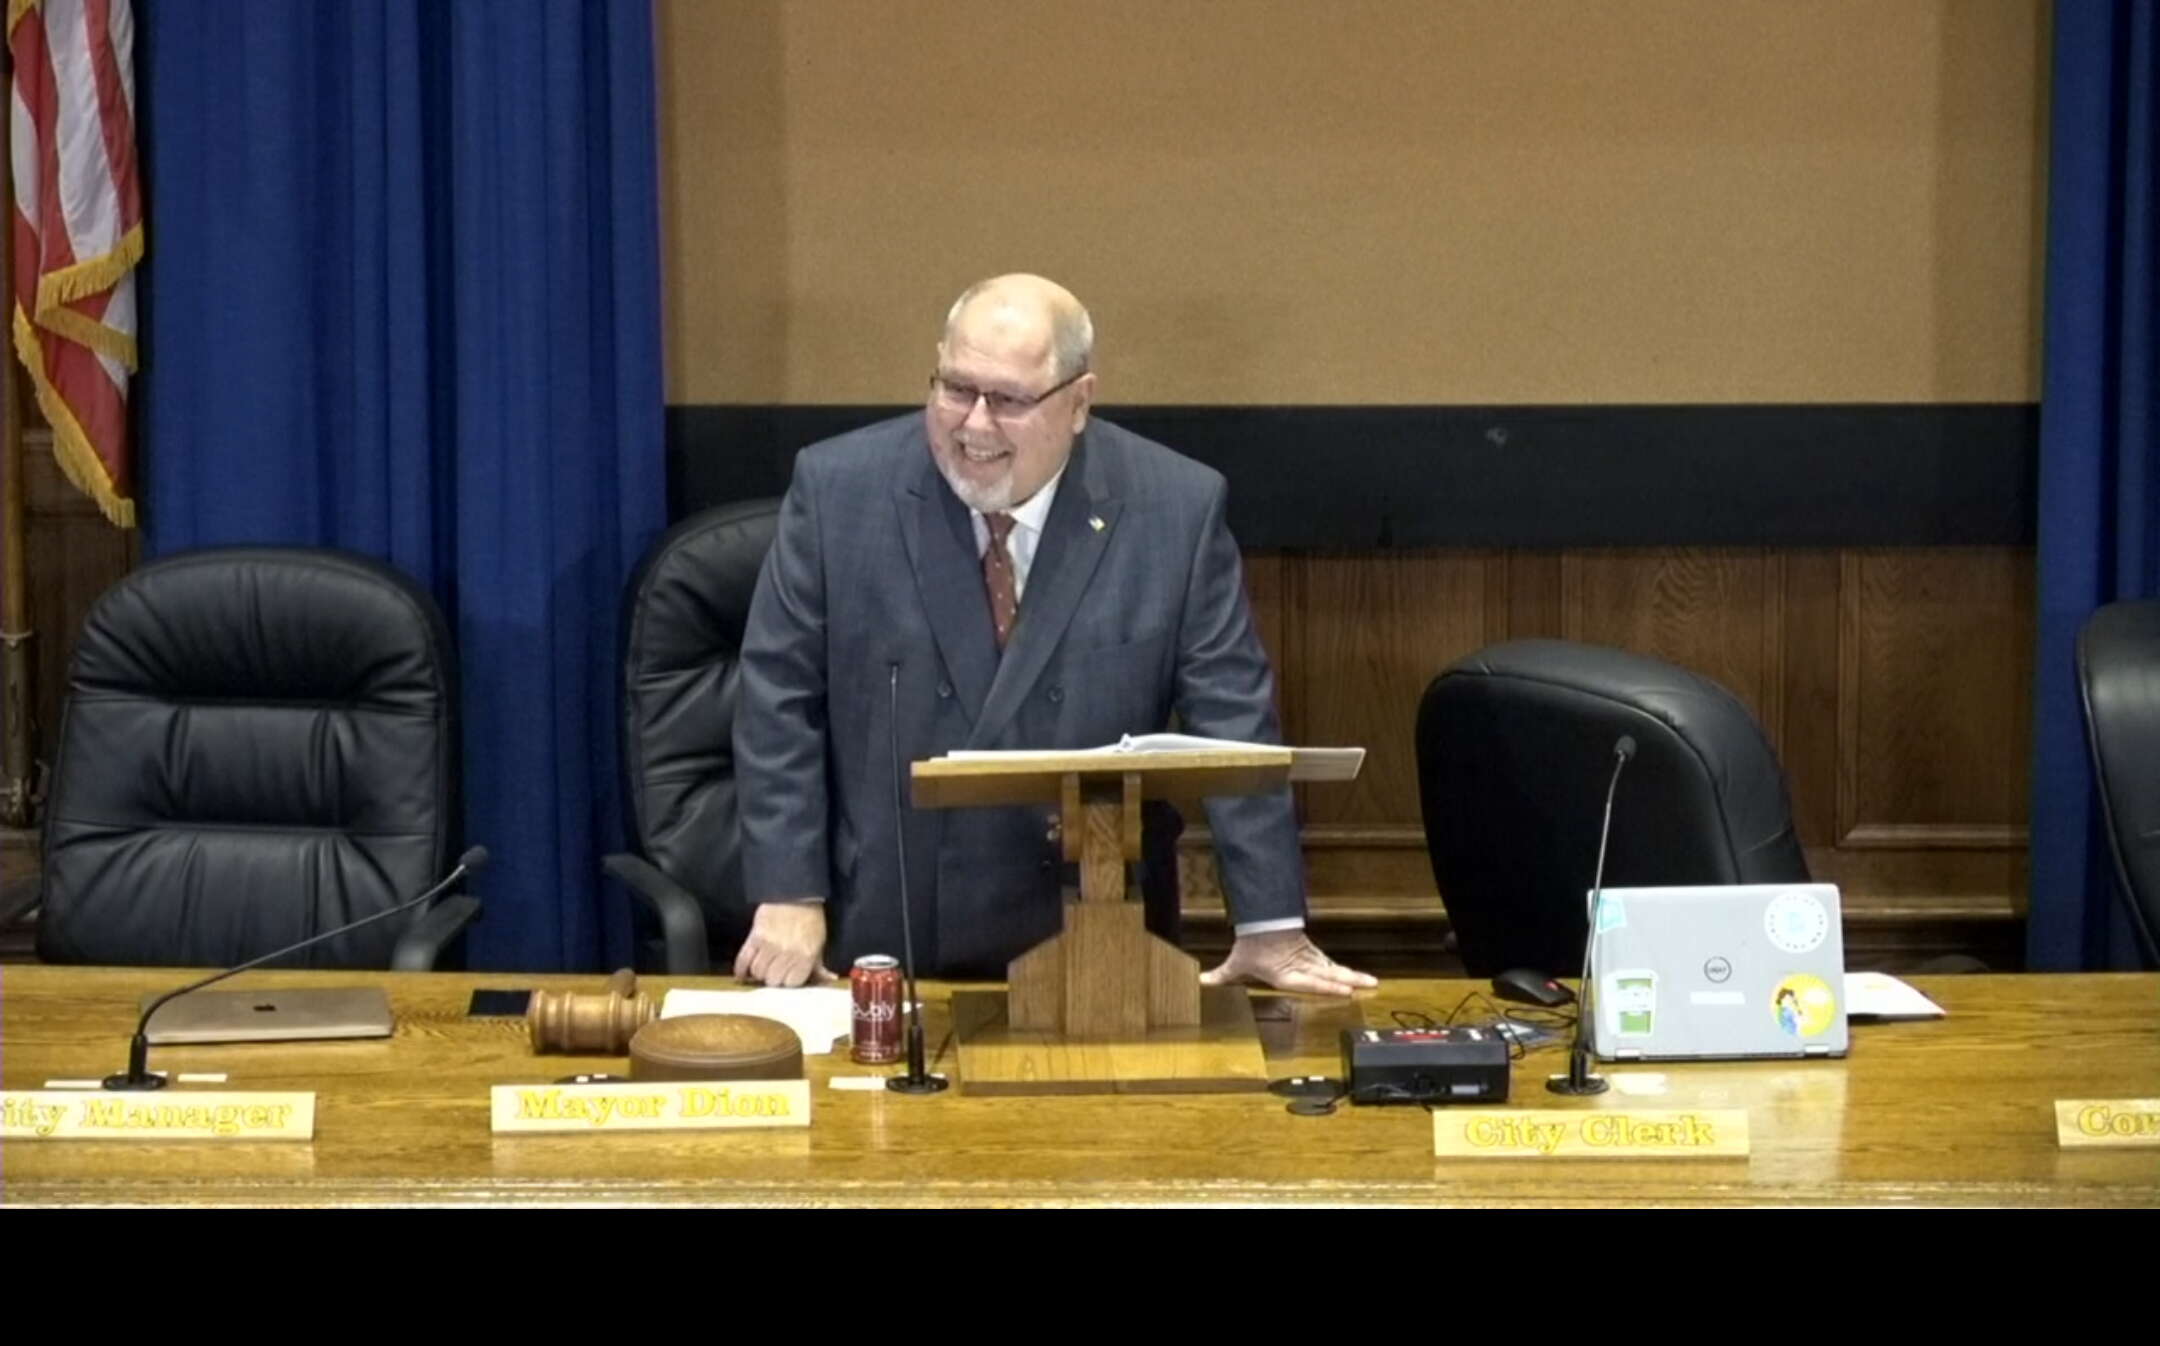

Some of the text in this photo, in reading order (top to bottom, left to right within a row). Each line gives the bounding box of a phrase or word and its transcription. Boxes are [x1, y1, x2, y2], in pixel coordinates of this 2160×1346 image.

[0, 1098, 293, 1135] ity Manager
[515, 1087, 792, 1125] Mayor Dion
[1464, 1115, 1716, 1154] City Clerk
